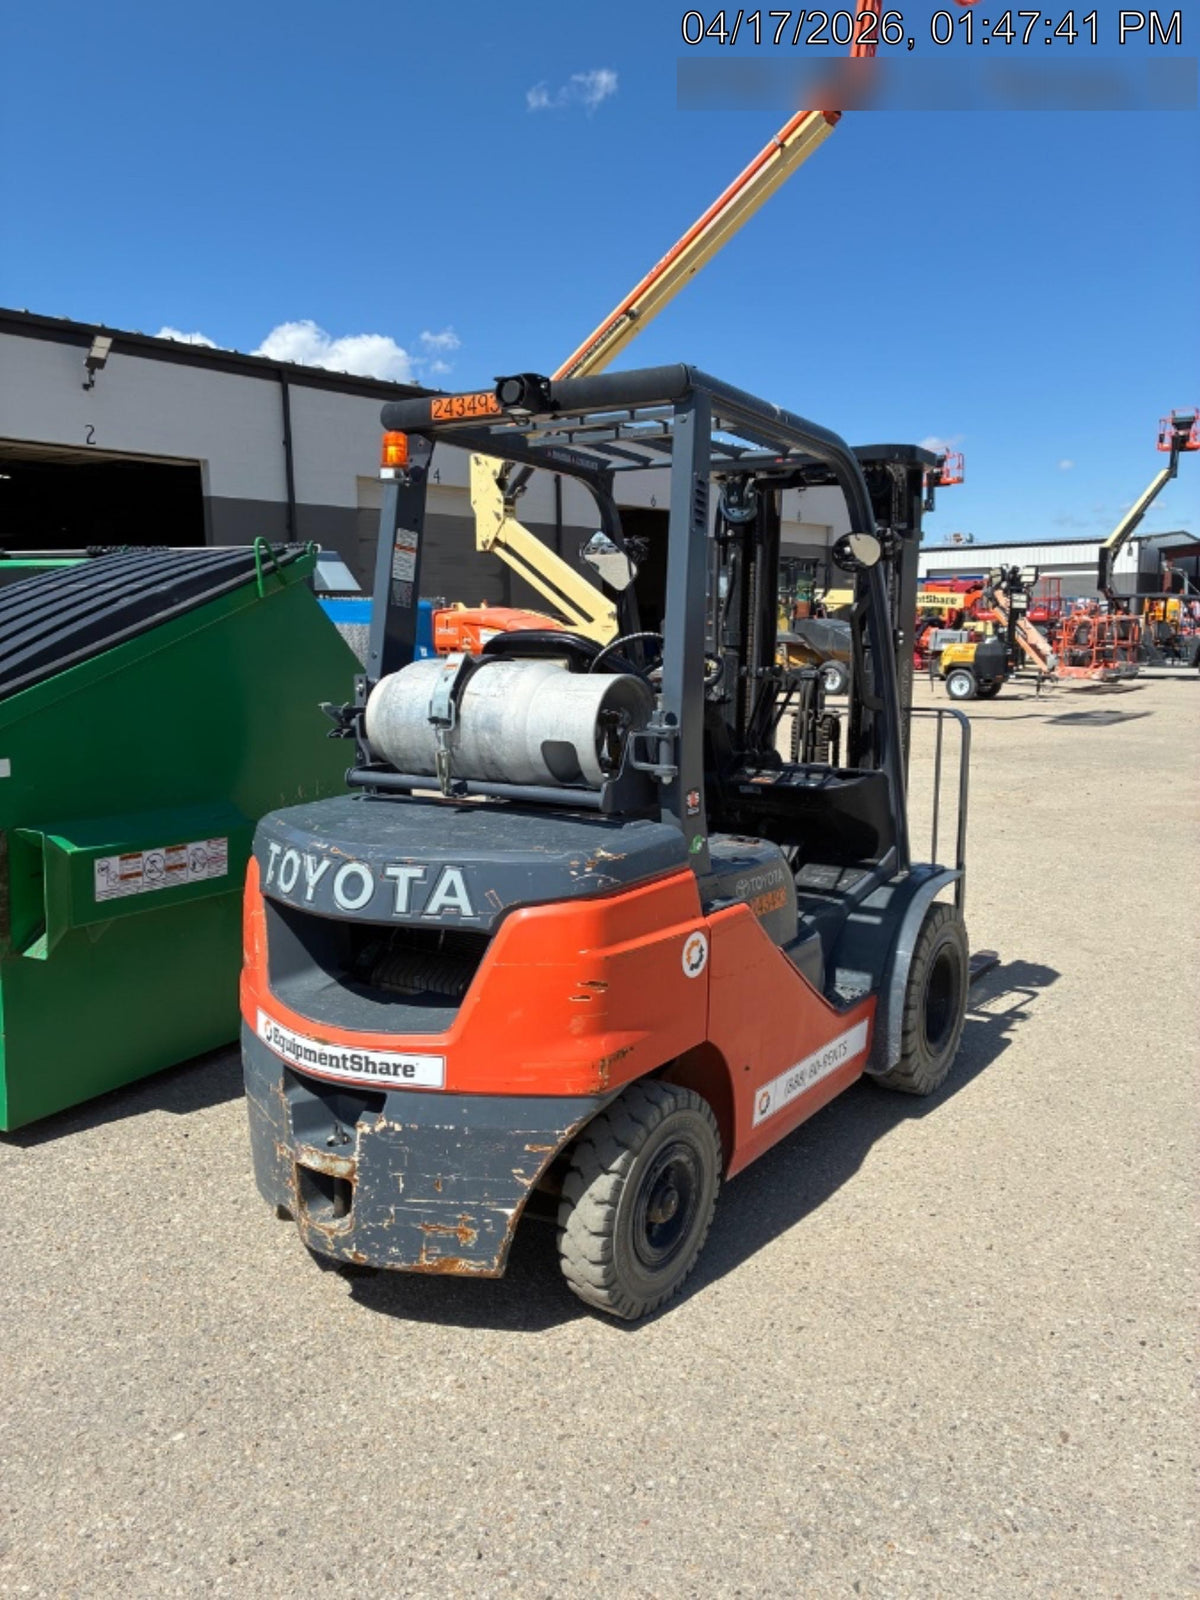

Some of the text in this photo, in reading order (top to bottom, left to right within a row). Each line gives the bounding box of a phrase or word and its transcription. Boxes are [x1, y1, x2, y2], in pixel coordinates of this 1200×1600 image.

[433, 394, 500, 419] 243493
[85, 424, 96, 445] 2
[433, 468, 441, 484] 4
[265, 841, 476, 918] TOYOTA
[273, 1027, 415, 1078] EquipmentShare
